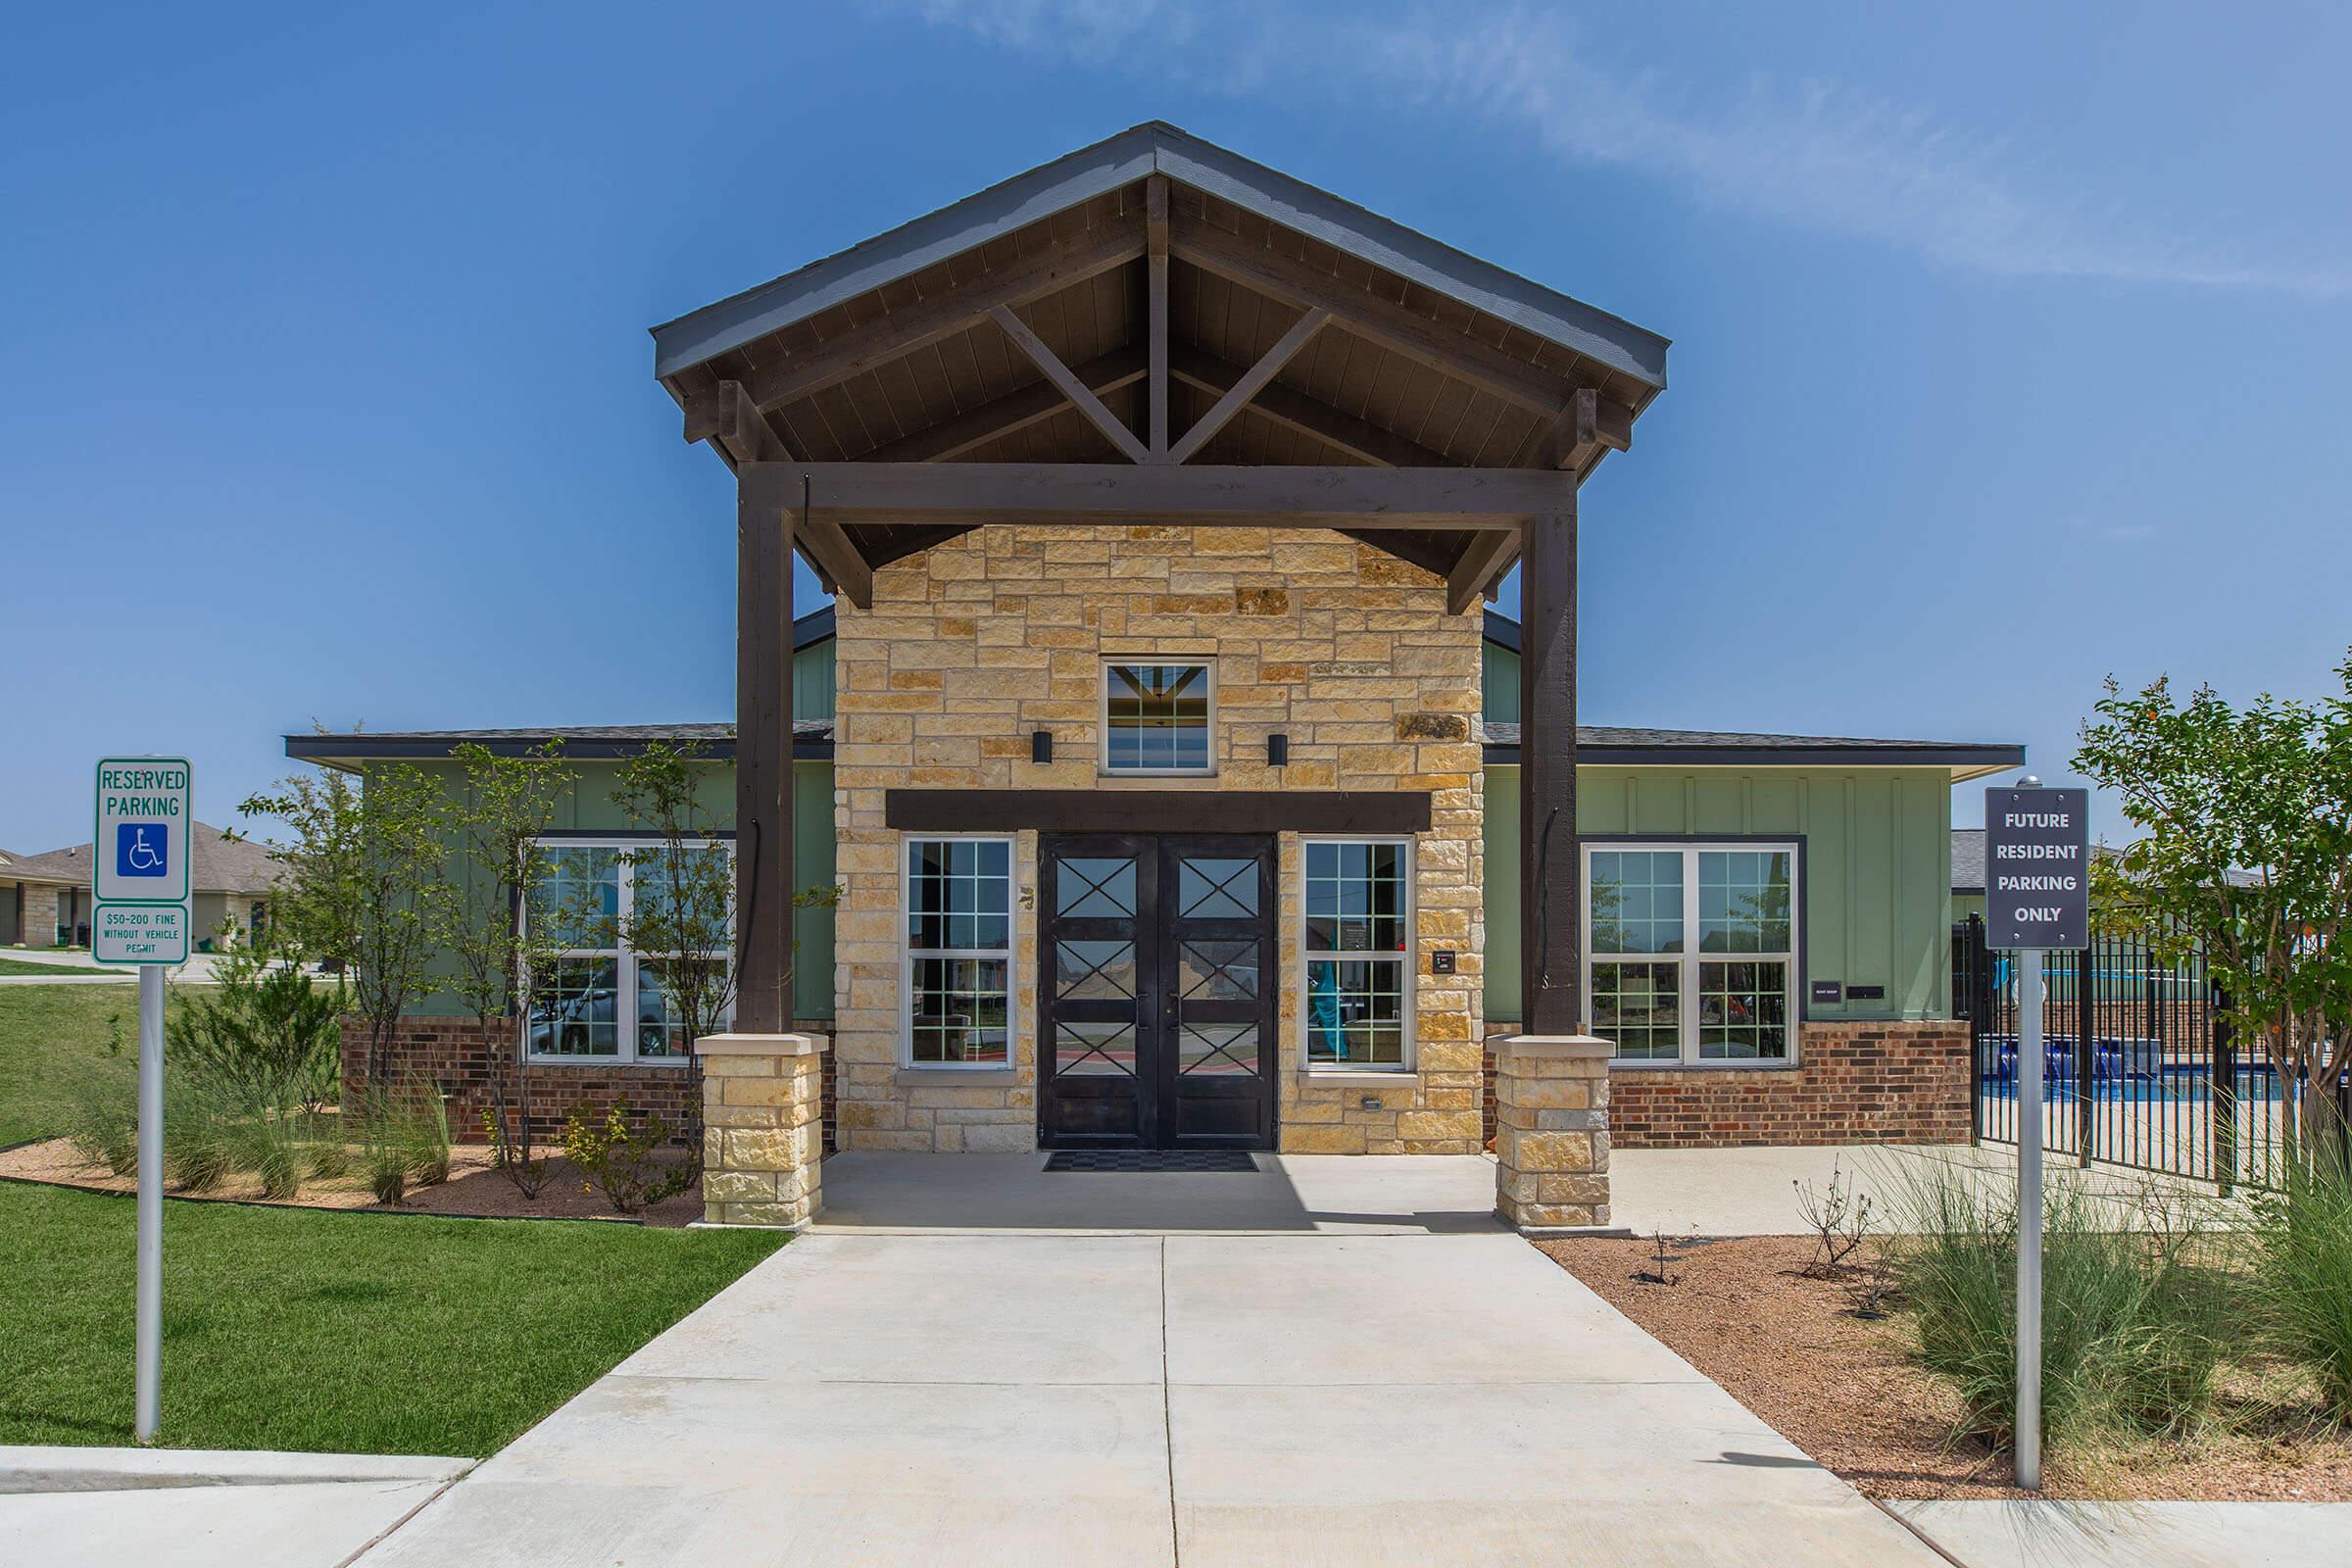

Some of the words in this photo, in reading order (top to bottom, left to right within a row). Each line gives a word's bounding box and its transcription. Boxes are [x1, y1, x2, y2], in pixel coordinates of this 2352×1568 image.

[102, 770, 185, 790] RESERVED
[107, 797, 179, 816] PARKING
[2005, 813, 2070, 828] FUTURE
[1996, 845, 2079, 859] RESIDENT
[1998, 876, 2078, 891] PARKING
[107, 913, 149, 925] $50-200
[155, 914, 176, 925] FINE
[2014, 907, 2063, 922] ONLY
[103, 929, 139, 940] WITHOUT
[145, 930, 178, 940] VEHICLE
